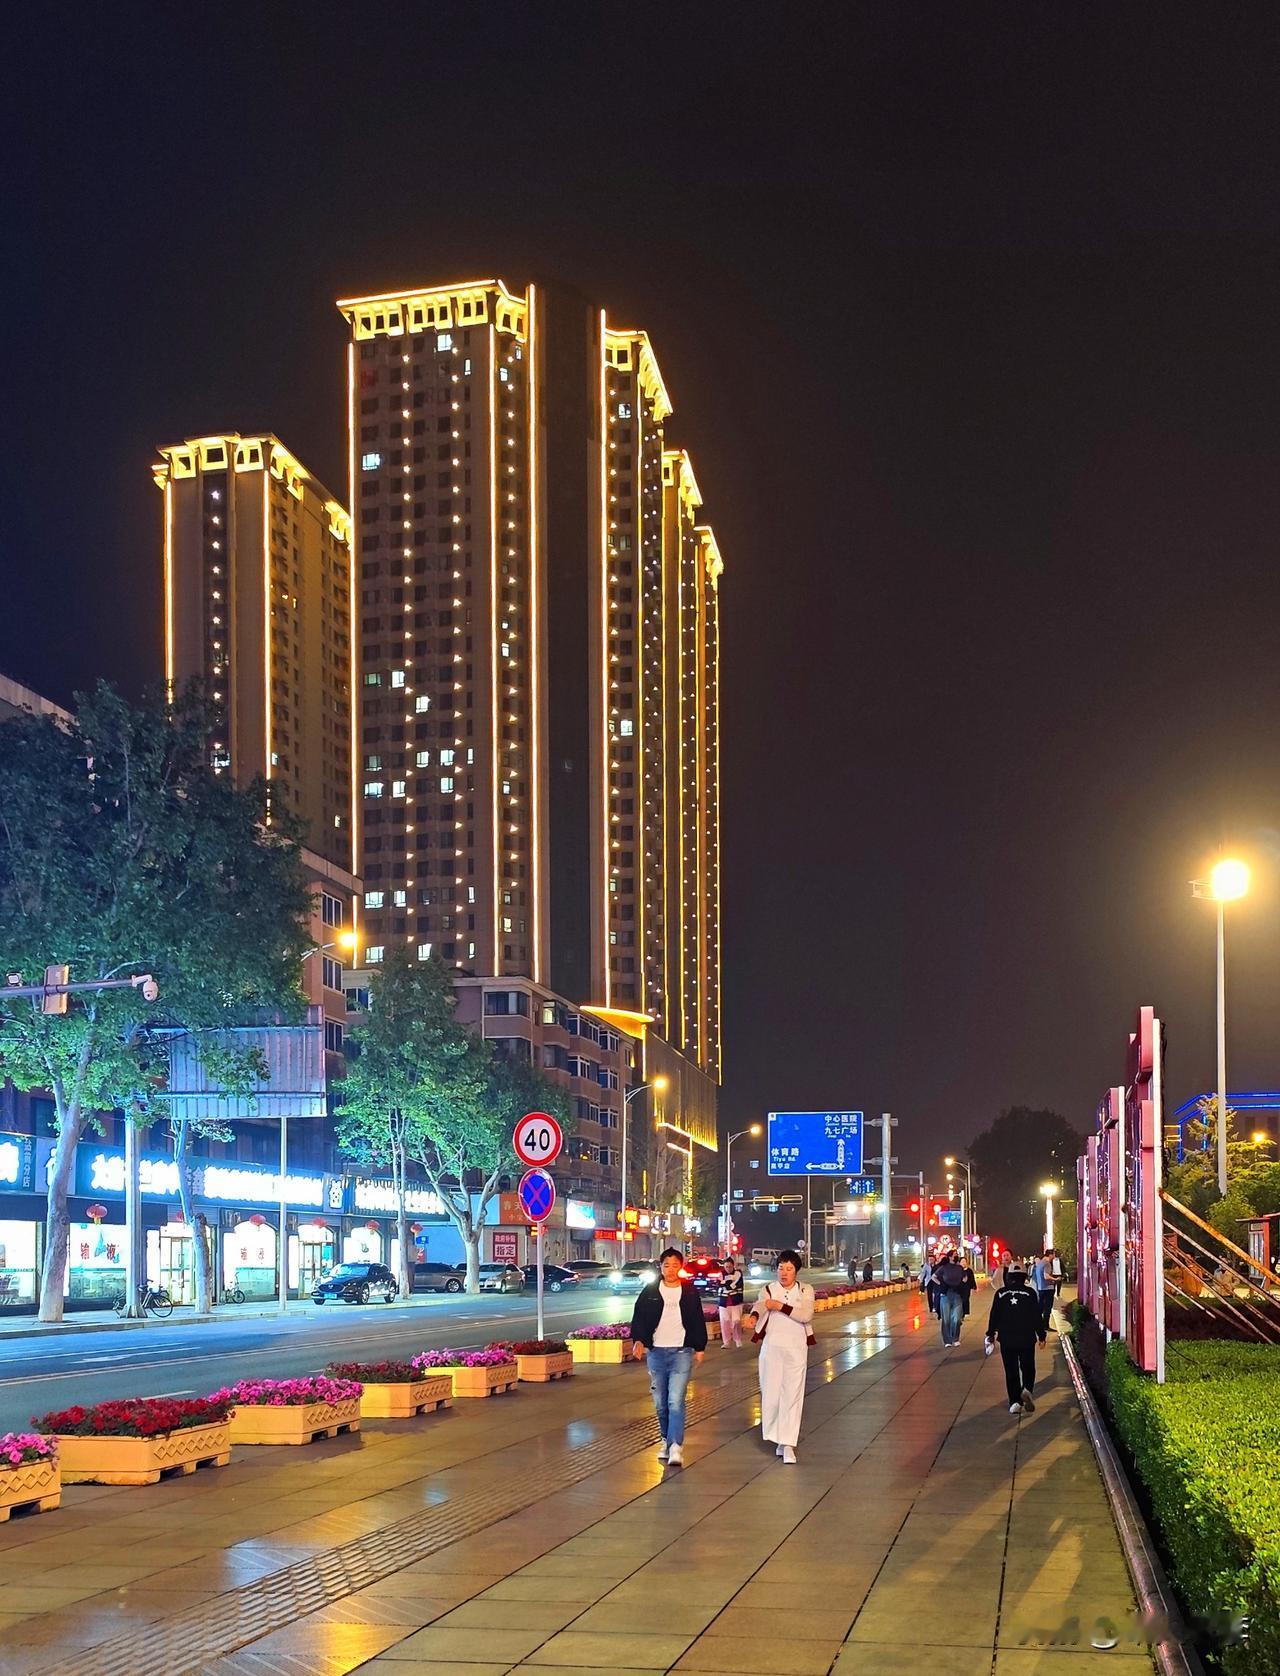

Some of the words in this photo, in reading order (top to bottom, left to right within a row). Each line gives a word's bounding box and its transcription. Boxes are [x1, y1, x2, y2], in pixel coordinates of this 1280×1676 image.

[824, 1114, 857, 1123] 中心医院
[824, 1126, 858, 1135] 九七广场
[524, 1128, 550, 1151] 40
[771, 1147, 799, 1156] 体育路
[496, 1245, 515, 1256] 指定
